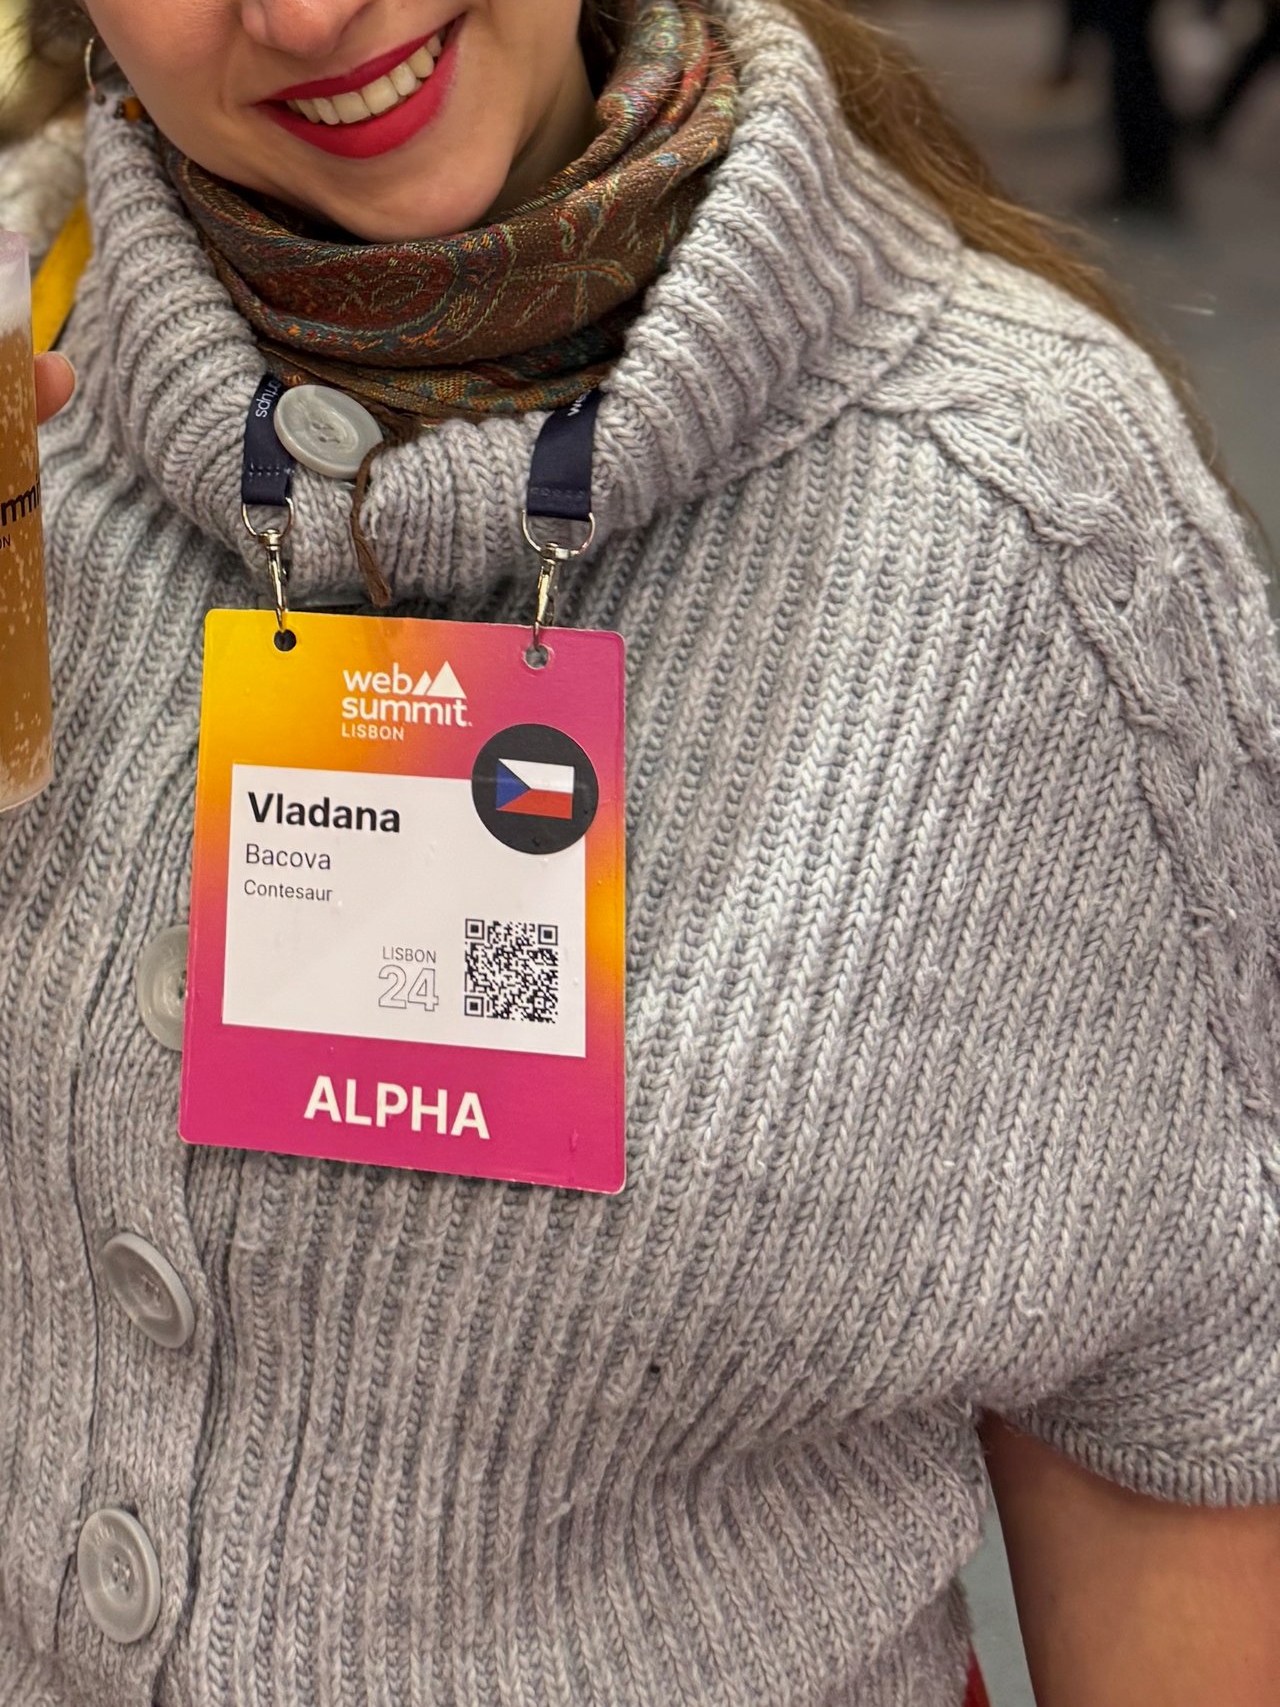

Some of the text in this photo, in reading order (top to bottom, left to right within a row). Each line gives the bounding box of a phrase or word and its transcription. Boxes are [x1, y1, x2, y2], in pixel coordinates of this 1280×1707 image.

[342, 661, 413, 695] web
[341, 722, 405, 741] LISBON
[248, 791, 401, 834] Vladana
[245, 843, 332, 870] Bacova
[243, 879, 333, 902] Contesaur
[382, 945, 436, 964] LISBON
[378, 964, 439, 1012] 24
[303, 1075, 491, 1140] ALPHA
